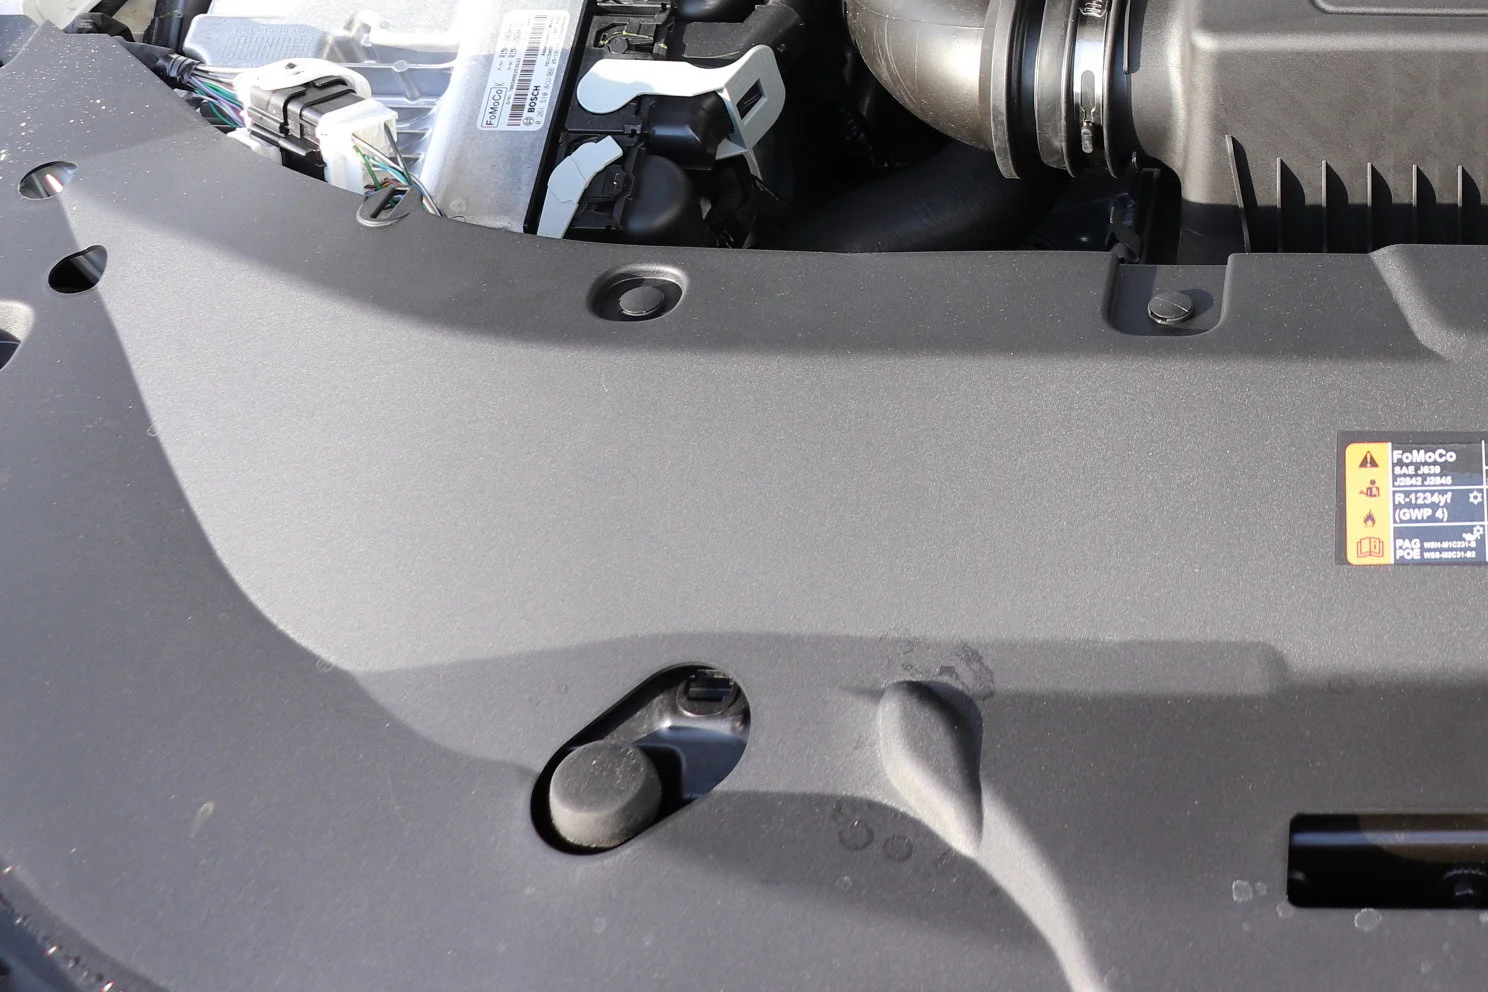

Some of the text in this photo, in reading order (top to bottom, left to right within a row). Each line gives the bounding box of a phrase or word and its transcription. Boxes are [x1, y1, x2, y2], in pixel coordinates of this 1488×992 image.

[527, 85, 541, 113] BOSCH
[485, 89, 503, 126] FoMoCo
[1392, 449, 1457, 463] FoMoCo
[1394, 466, 1415, 474] SAE
[1394, 492, 1452, 506] R-1234yf
[1395, 507, 1448, 523] (GWP 4)
[1396, 538, 1420, 550] PAG
[1396, 549, 1421, 560] POE
